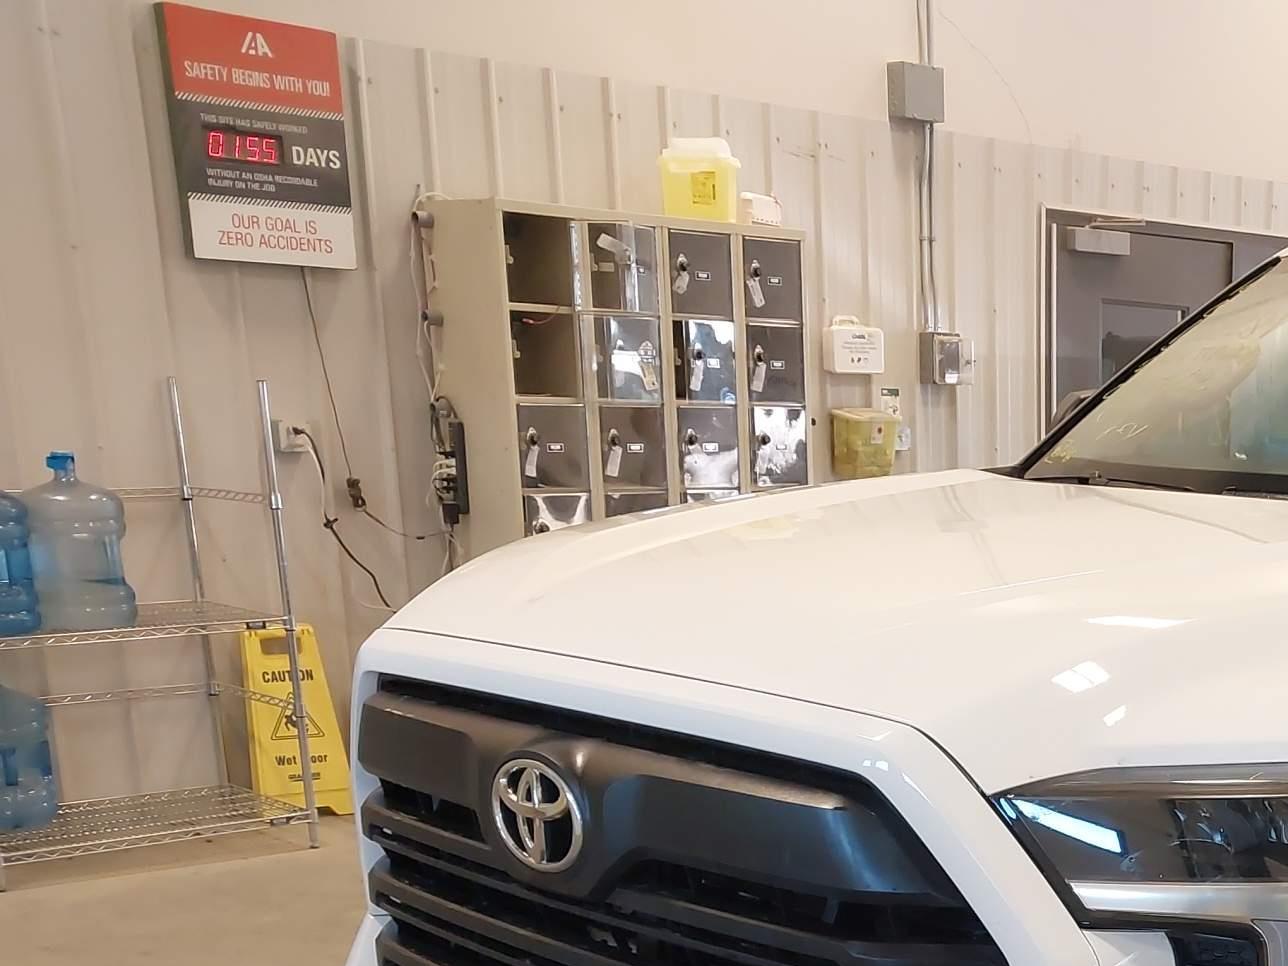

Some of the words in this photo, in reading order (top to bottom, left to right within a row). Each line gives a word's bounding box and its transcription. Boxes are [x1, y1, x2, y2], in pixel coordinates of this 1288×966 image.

[184, 60, 228, 82] SAFETY
[232, 69, 271, 89] BEGINS
[273, 74, 302, 92] WITH
[306, 80, 330, 97] YOU!
[208, 132, 278, 162] 0155
[292, 146, 341, 169] DAYS
[206, 168, 241, 179] WITHOUT
[235, 180, 246, 189] ON
[247, 182, 261, 190] THE
[231, 213, 260, 230] OUR
[265, 216, 300, 234] GOAL
[305, 219, 317, 235] IS
[217, 230, 254, 248] ZERO
[259, 234, 333, 254] ACCIDENTS
[262, 669, 314, 683] CAUTON
[275, 755, 298, 767] Wet
